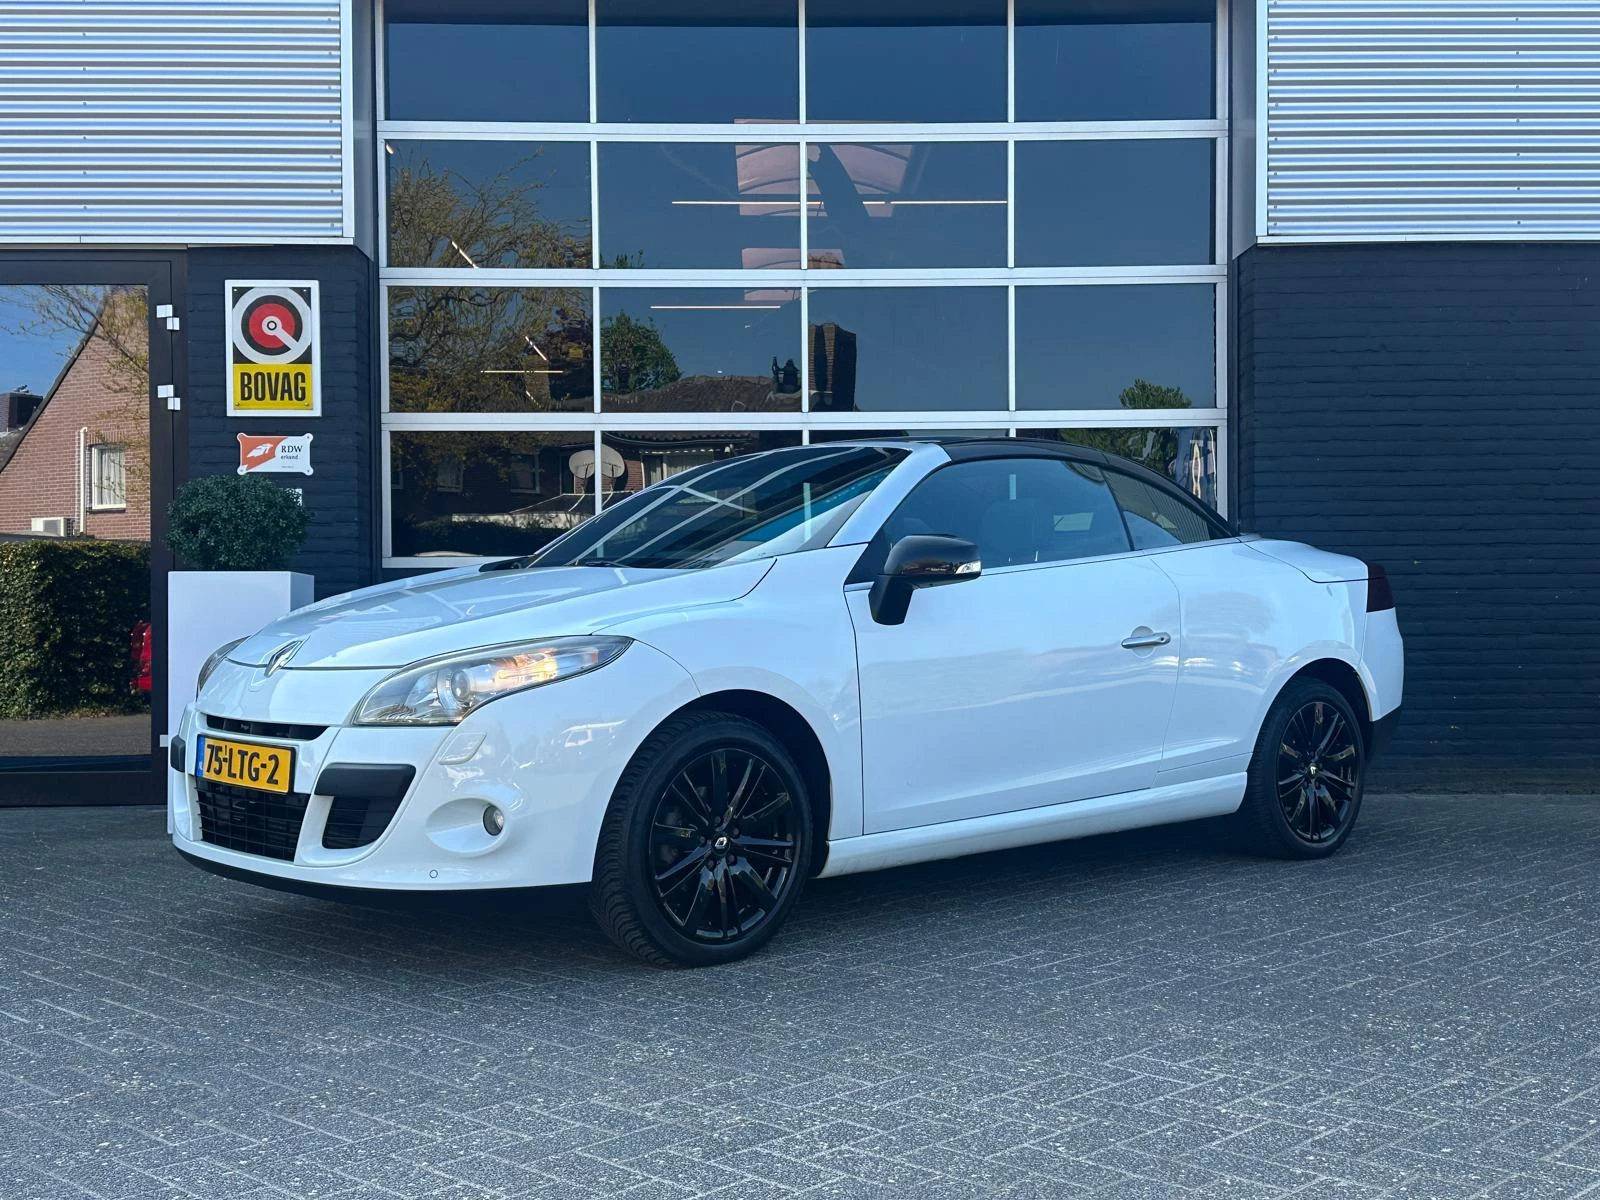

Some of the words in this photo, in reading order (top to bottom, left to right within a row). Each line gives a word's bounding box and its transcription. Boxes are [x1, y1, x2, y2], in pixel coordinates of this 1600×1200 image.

[240, 371, 306, 402] BOVAG
[281, 445, 303, 453] RDW
[206, 744, 279, 785] 75-LTG-2
